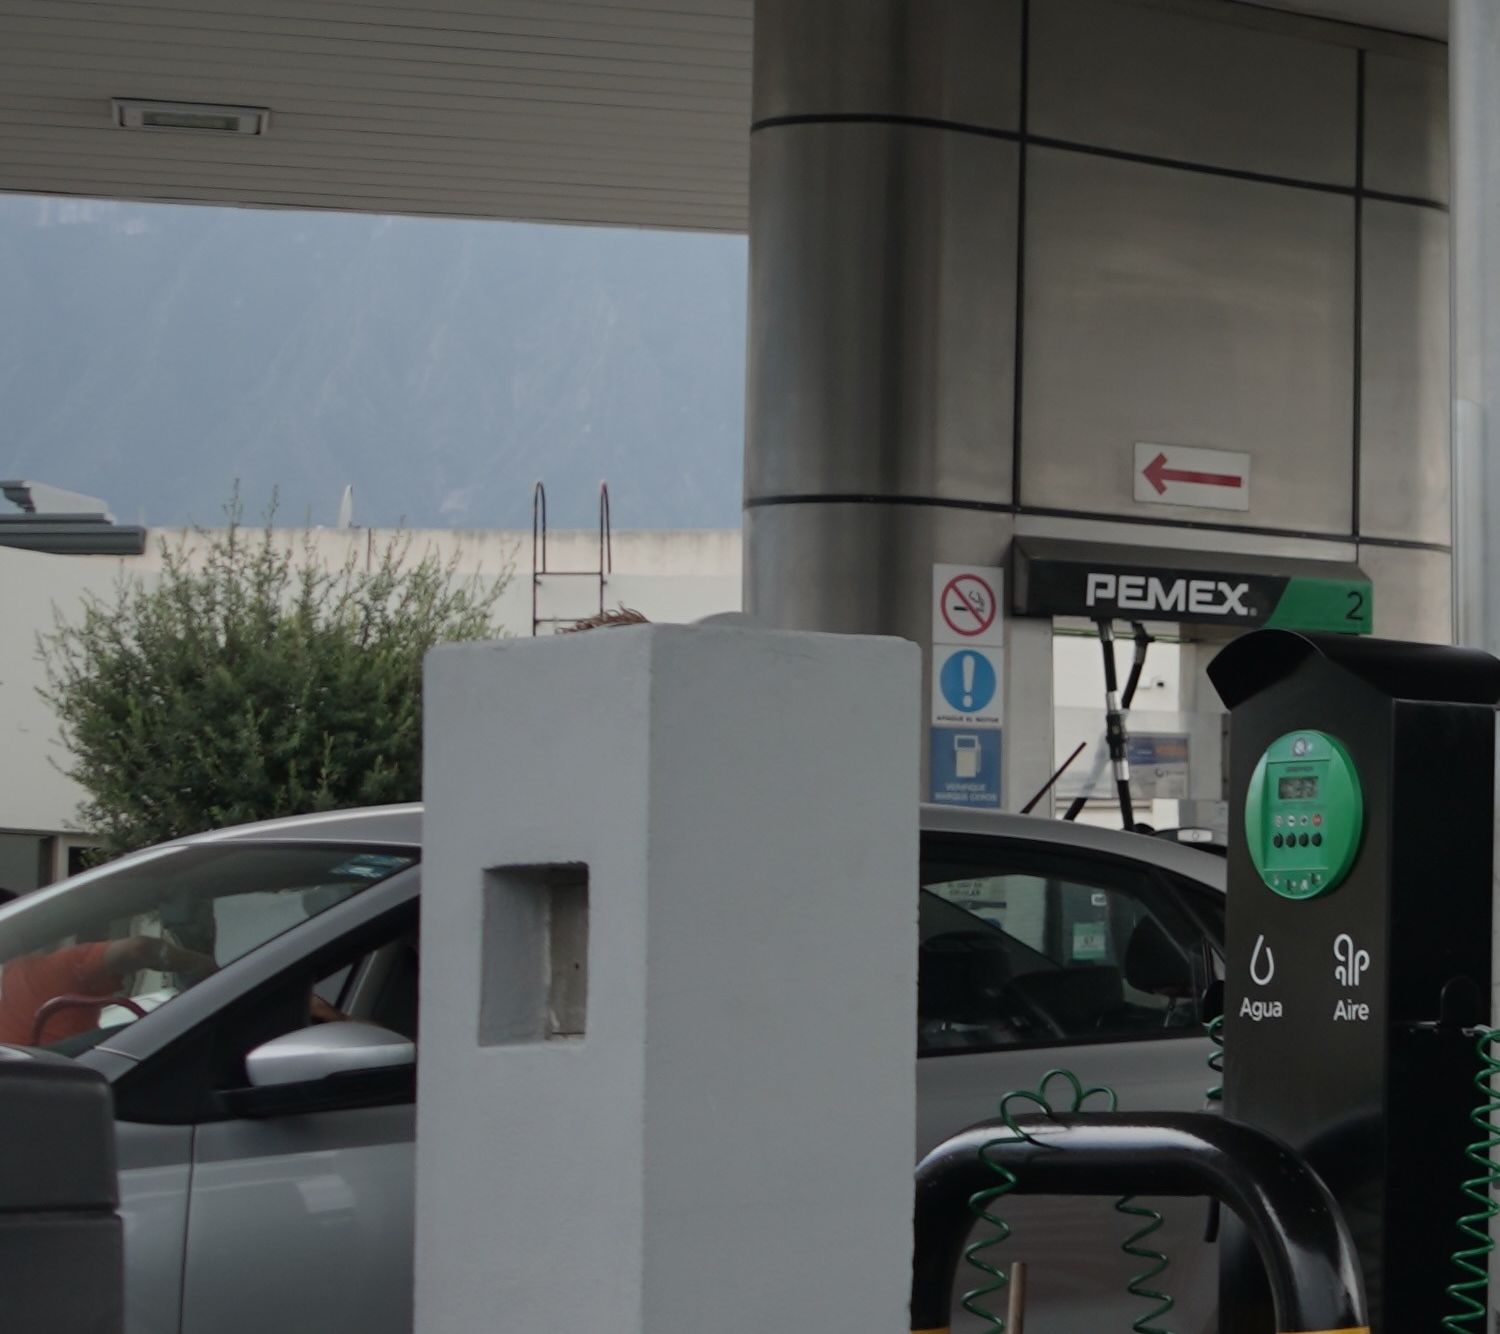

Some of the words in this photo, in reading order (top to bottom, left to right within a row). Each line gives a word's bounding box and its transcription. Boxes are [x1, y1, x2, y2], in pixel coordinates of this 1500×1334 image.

[1086, 572, 1249, 616] PEMEX
[1345, 590, 1364, 622] 2
[1239, 996, 1282, 1021] Agua
[1333, 999, 1369, 1021] Aire
